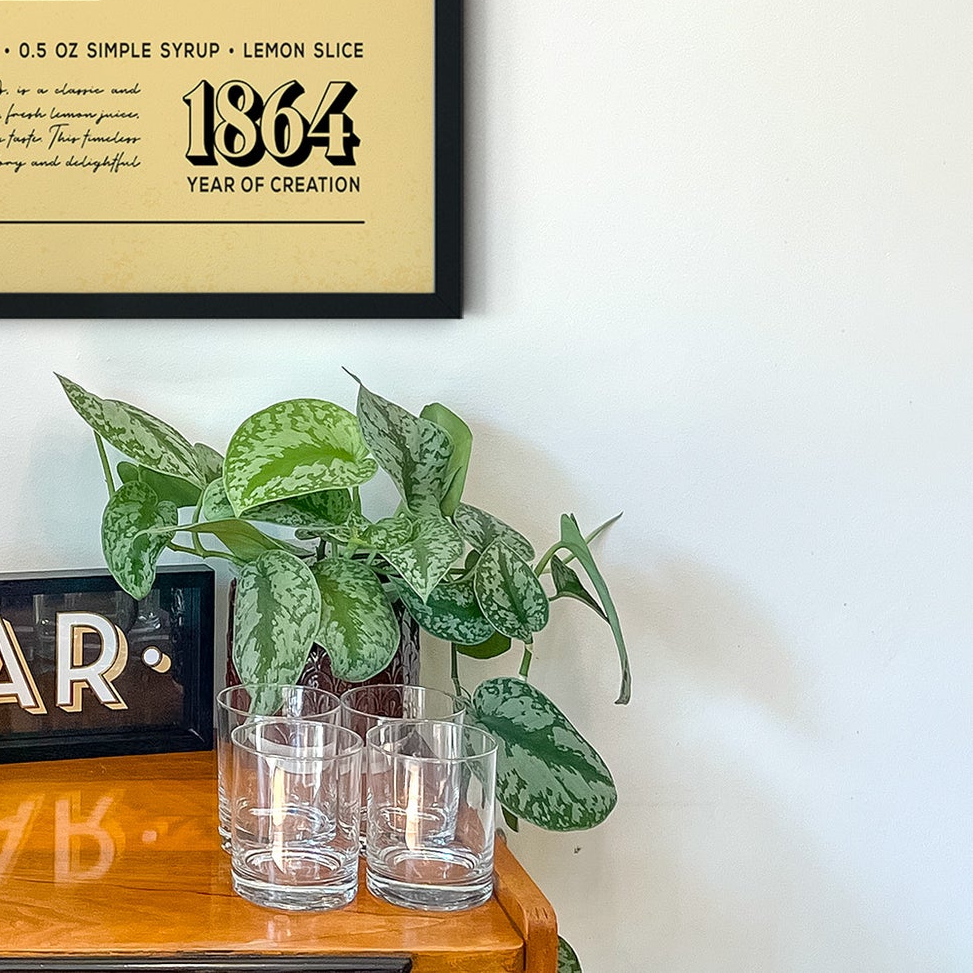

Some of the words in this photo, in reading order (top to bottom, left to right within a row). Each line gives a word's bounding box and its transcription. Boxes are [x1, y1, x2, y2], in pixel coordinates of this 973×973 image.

[19, 42, 47, 59] 0.5
[55, 42, 78, 59] OZ
[86, 42, 151, 59] SIMPLE
[160, 42, 220, 59] SYRUP
[243, 42, 305, 59] LEMON
[313, 42, 364, 59] SLICE
[17, 86, 31, 95] is
[54, 83, 104, 96] classic
[111, 83, 141, 95] and
[5, 104, 47, 124] fresh
[50, 108, 98, 119] lemon
[182, 79, 361, 168] 1864
[48, 123, 80, 150] This
[81, 129, 141, 148] timeless
[31, 156, 62, 167] and
[66, 152, 141, 173] delightful
[186, 176, 235, 193] YEAR
[240, 176, 265, 193] OF
[270, 176, 360, 193] CREATION
